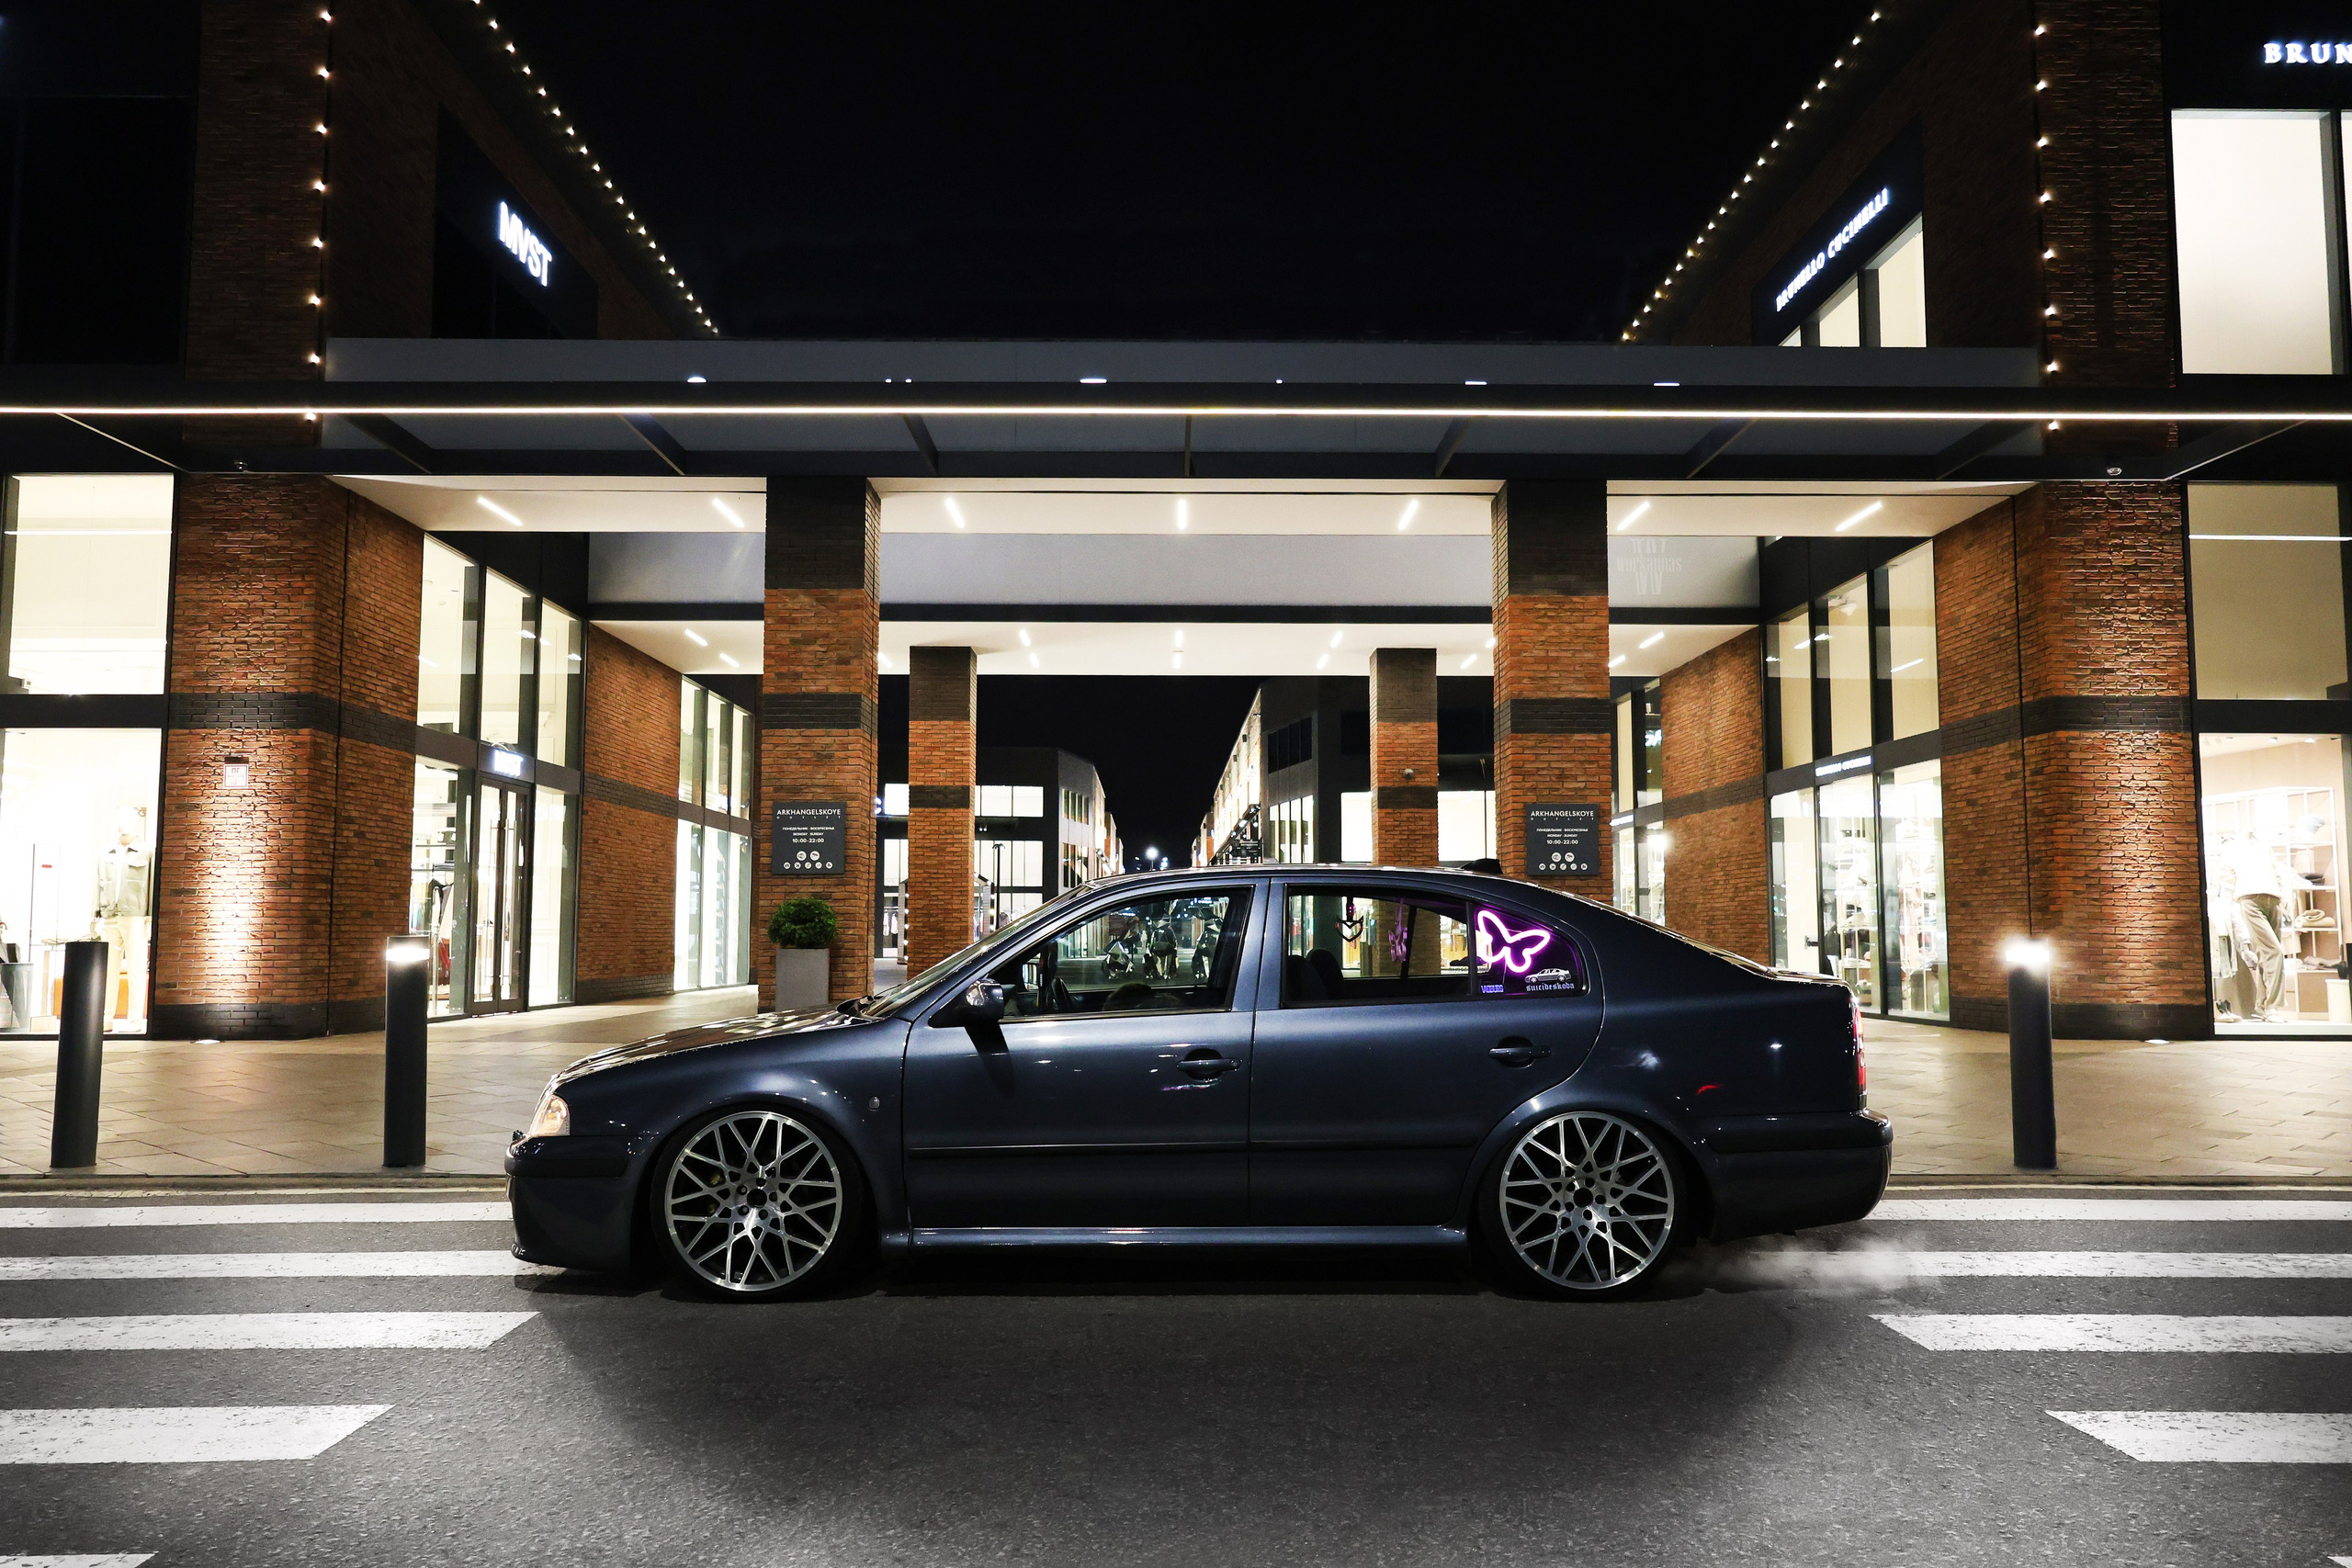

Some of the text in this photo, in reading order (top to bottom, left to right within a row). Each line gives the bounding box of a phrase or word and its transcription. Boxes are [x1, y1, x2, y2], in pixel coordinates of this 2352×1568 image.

[2263, 42, 2352, 64] BRUN
[1775, 187, 1889, 312] BRUNELLO CUCINELLI
[1525, 982, 1576, 992] suicideskoda
